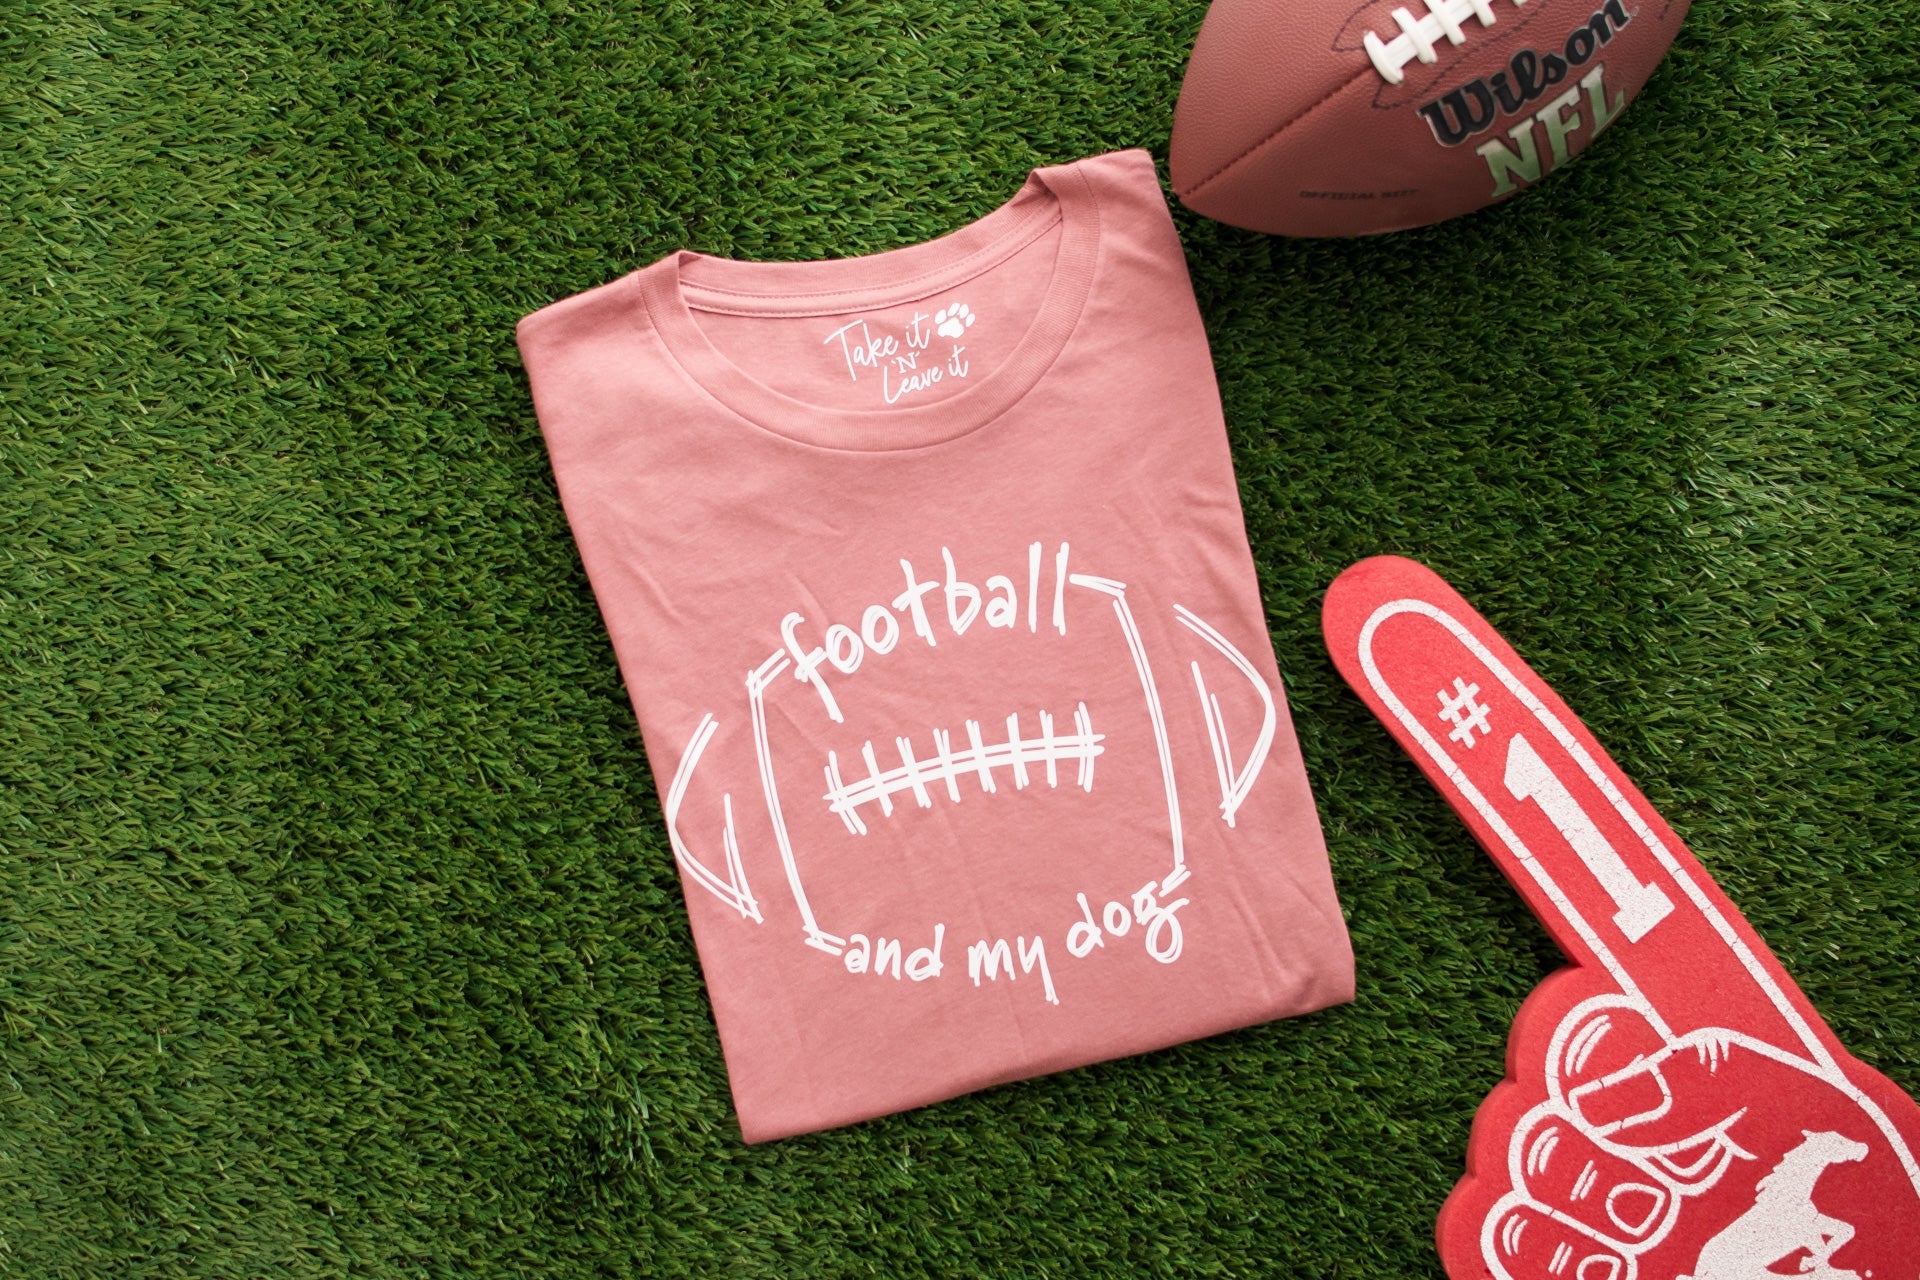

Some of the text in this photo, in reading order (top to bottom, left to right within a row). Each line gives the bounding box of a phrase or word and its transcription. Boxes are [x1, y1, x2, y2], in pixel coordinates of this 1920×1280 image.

[1416, 0, 1631, 147] Wilson
[1476, 62, 1627, 198] NFL
[824, 312, 931, 381] Take it
[883, 345, 969, 404] Leave it
[781, 541, 1069, 722] football
[844, 881, 1190, 1005] and my dog
